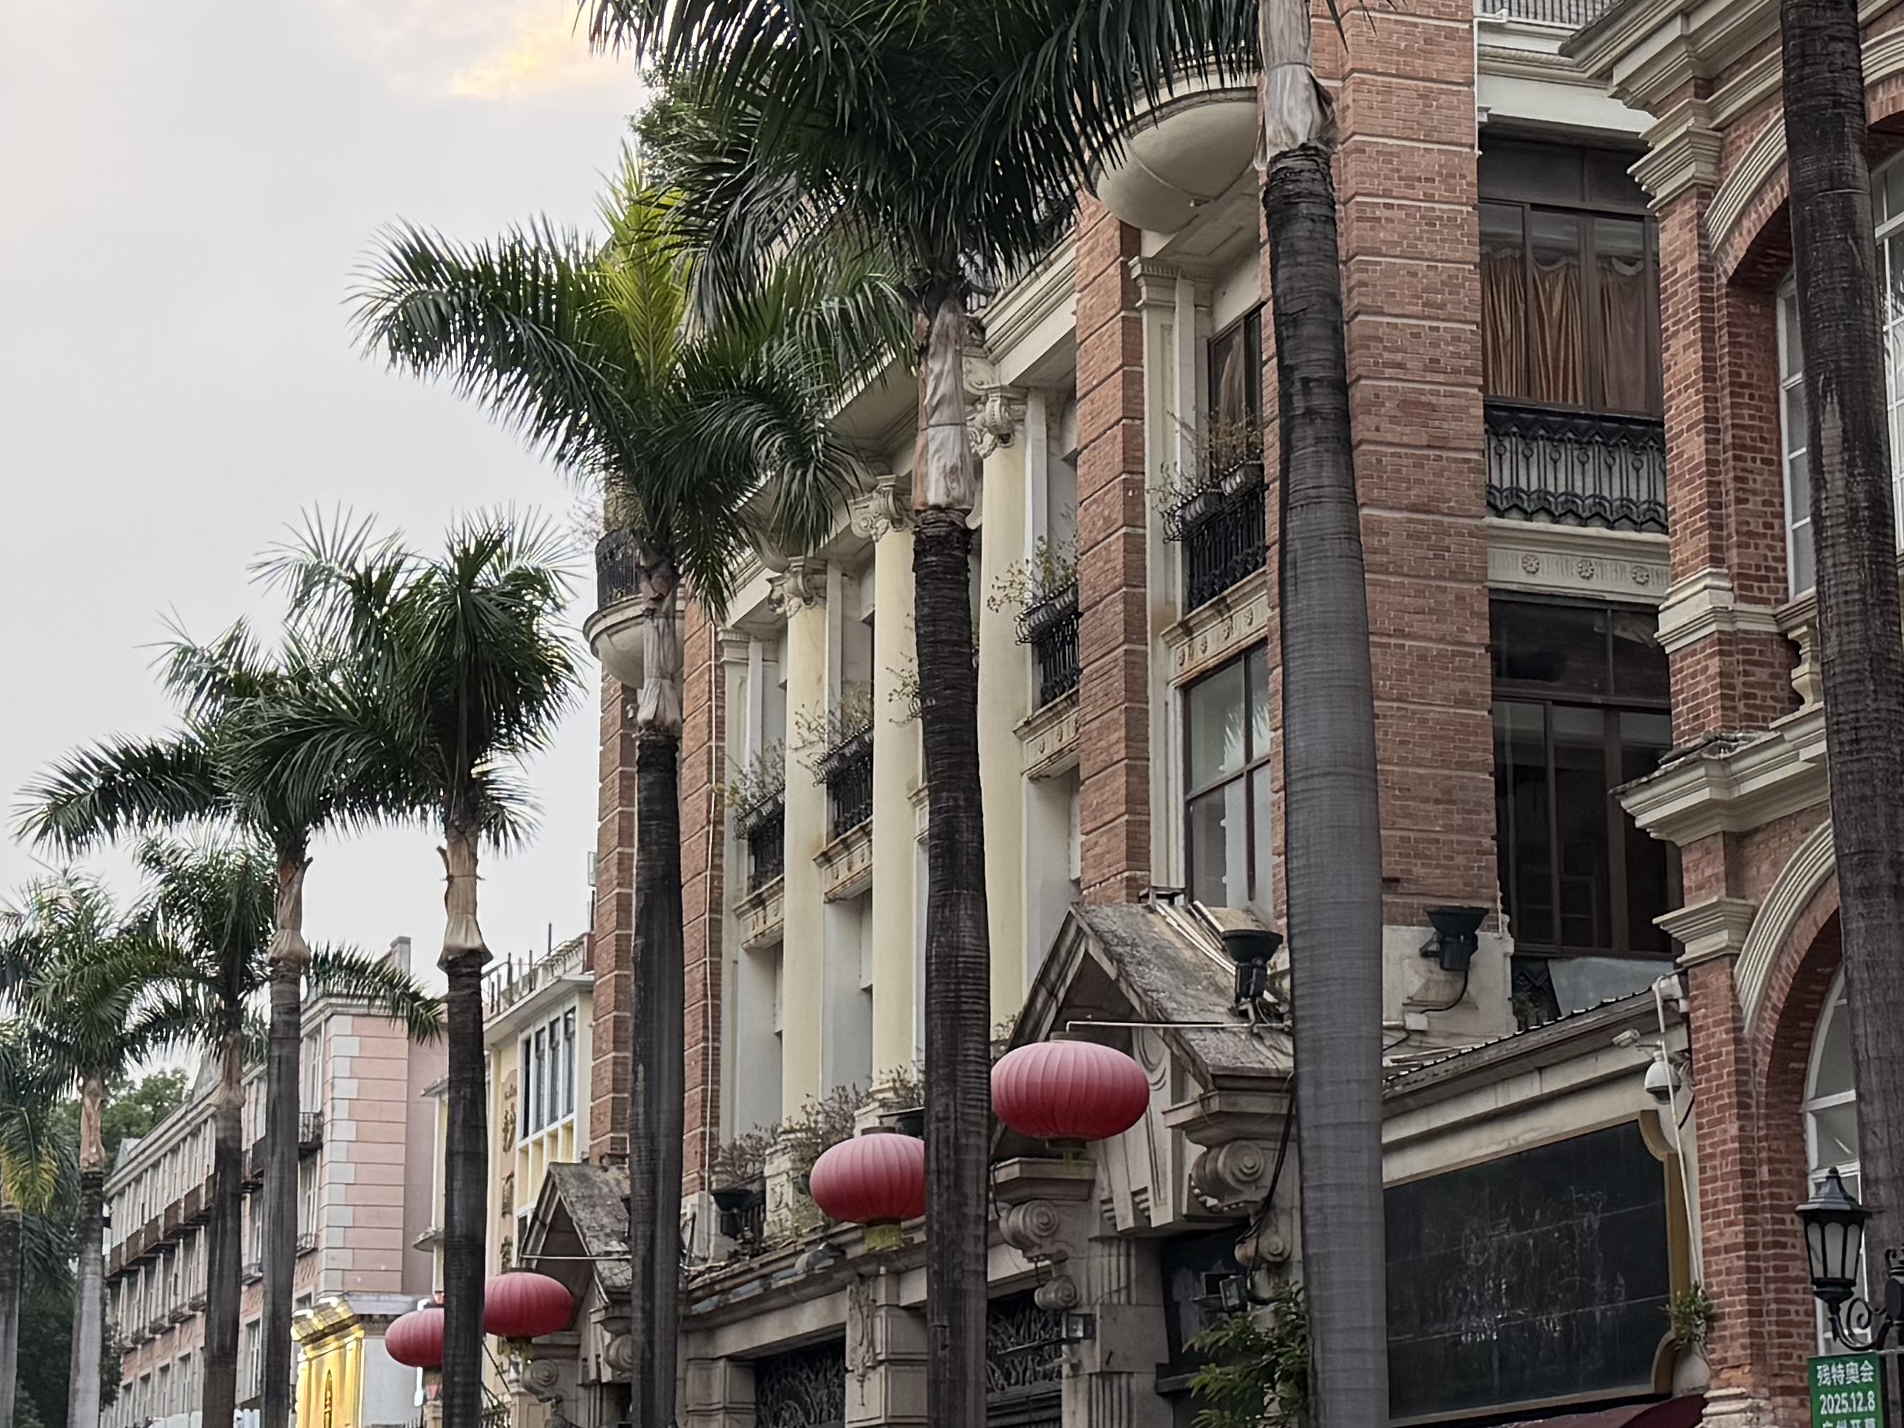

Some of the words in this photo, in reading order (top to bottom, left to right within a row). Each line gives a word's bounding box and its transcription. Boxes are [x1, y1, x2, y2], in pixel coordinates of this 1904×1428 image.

[1816, 1360, 1874, 1387] 残特奥会
[1819, 1390, 1876, 1415] 2025.12.8
